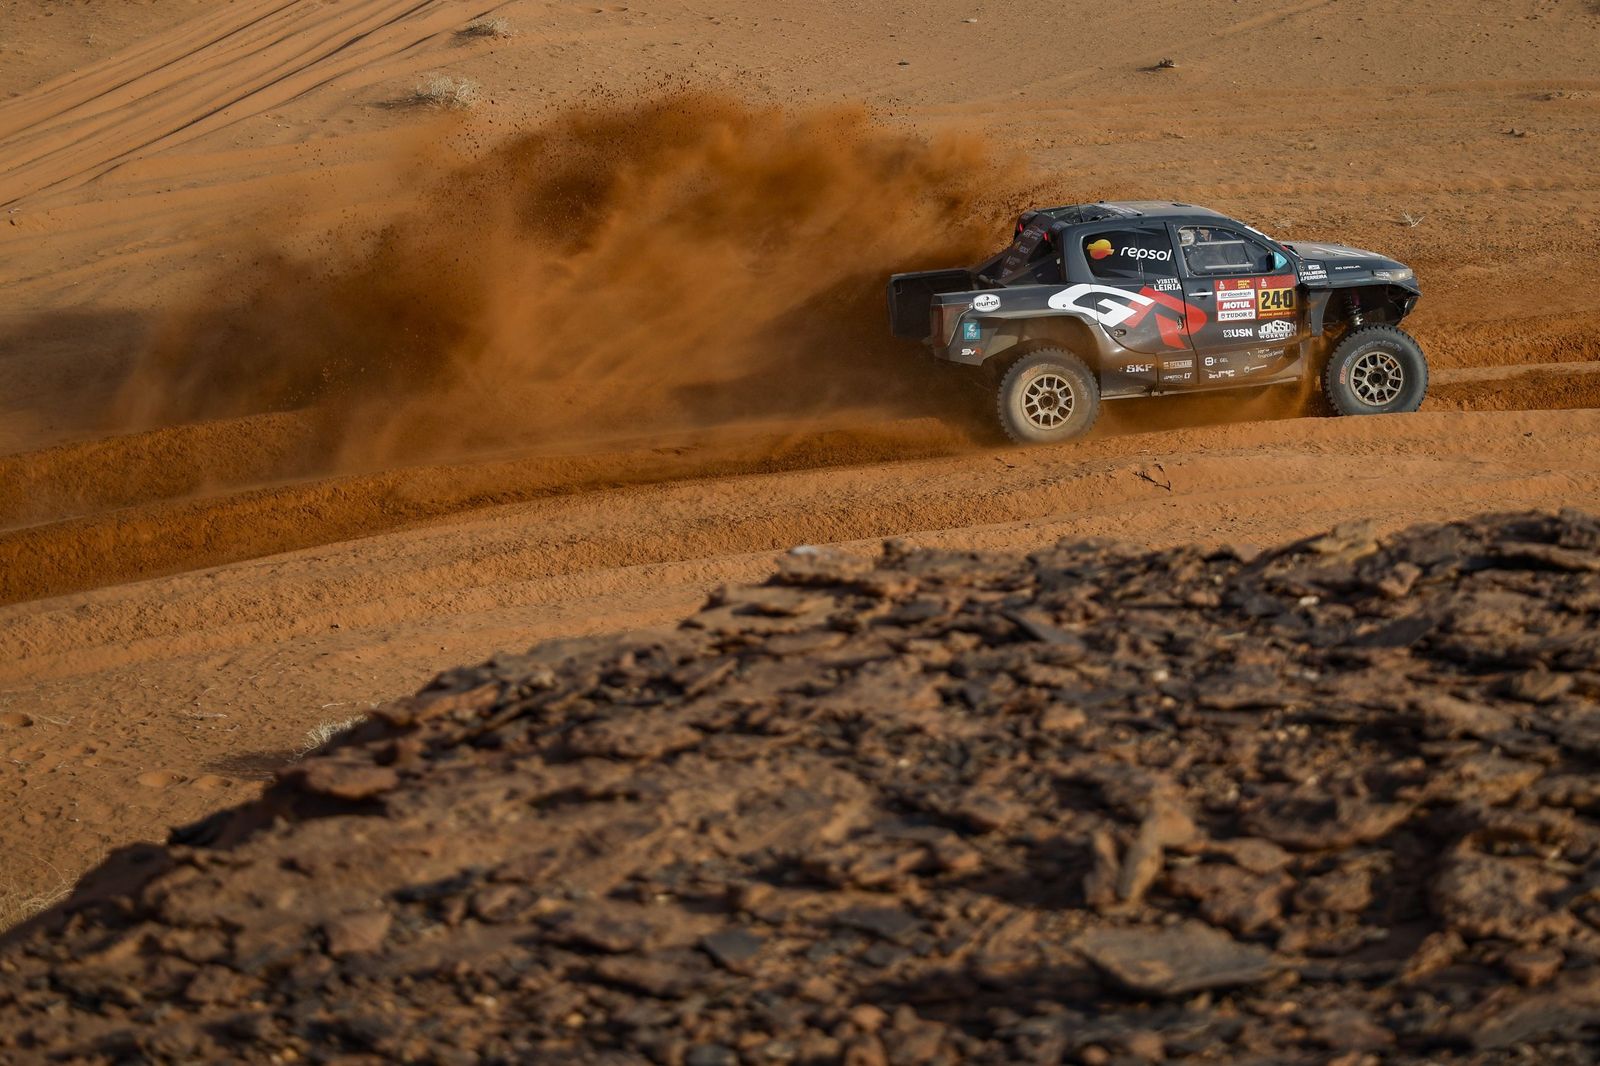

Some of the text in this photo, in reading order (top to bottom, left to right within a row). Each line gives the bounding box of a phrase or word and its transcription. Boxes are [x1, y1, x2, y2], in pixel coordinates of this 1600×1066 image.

[1120, 246, 1172, 261] repsol
[1153, 284, 1182, 292] LEIRIA
[976, 299, 998, 307] eurol
[1261, 289, 1294, 310] 240
[1222, 301, 1251, 309] MOTUL
[1258, 320, 1297, 334] JONSSON
[1232, 328, 1253, 337] USN
[1126, 363, 1155, 373] SKF
